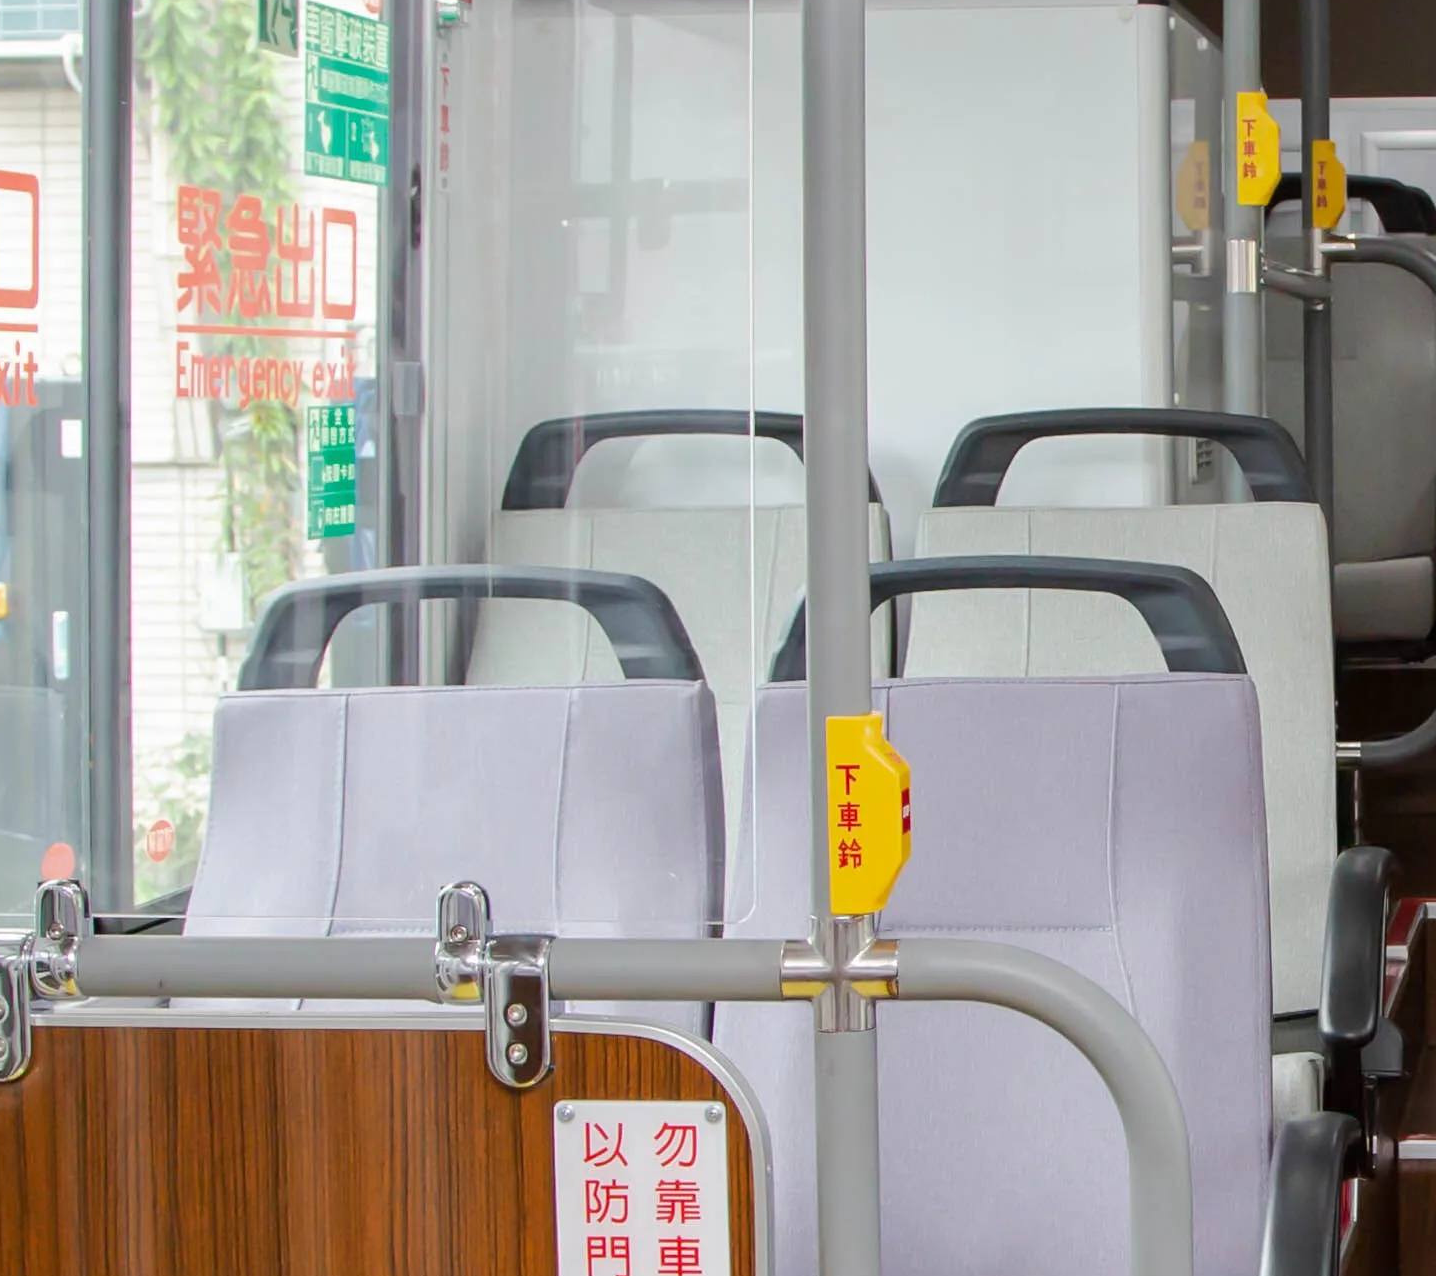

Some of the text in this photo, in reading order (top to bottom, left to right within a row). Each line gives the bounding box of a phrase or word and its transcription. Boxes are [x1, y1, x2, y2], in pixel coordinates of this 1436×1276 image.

[1242, 119, 1257, 179] 下車鈴
[176, 184, 357, 321] 緊急出口
[176, 341, 357, 409] Emergency exit
[835, 765, 862, 869] 下車鈴
